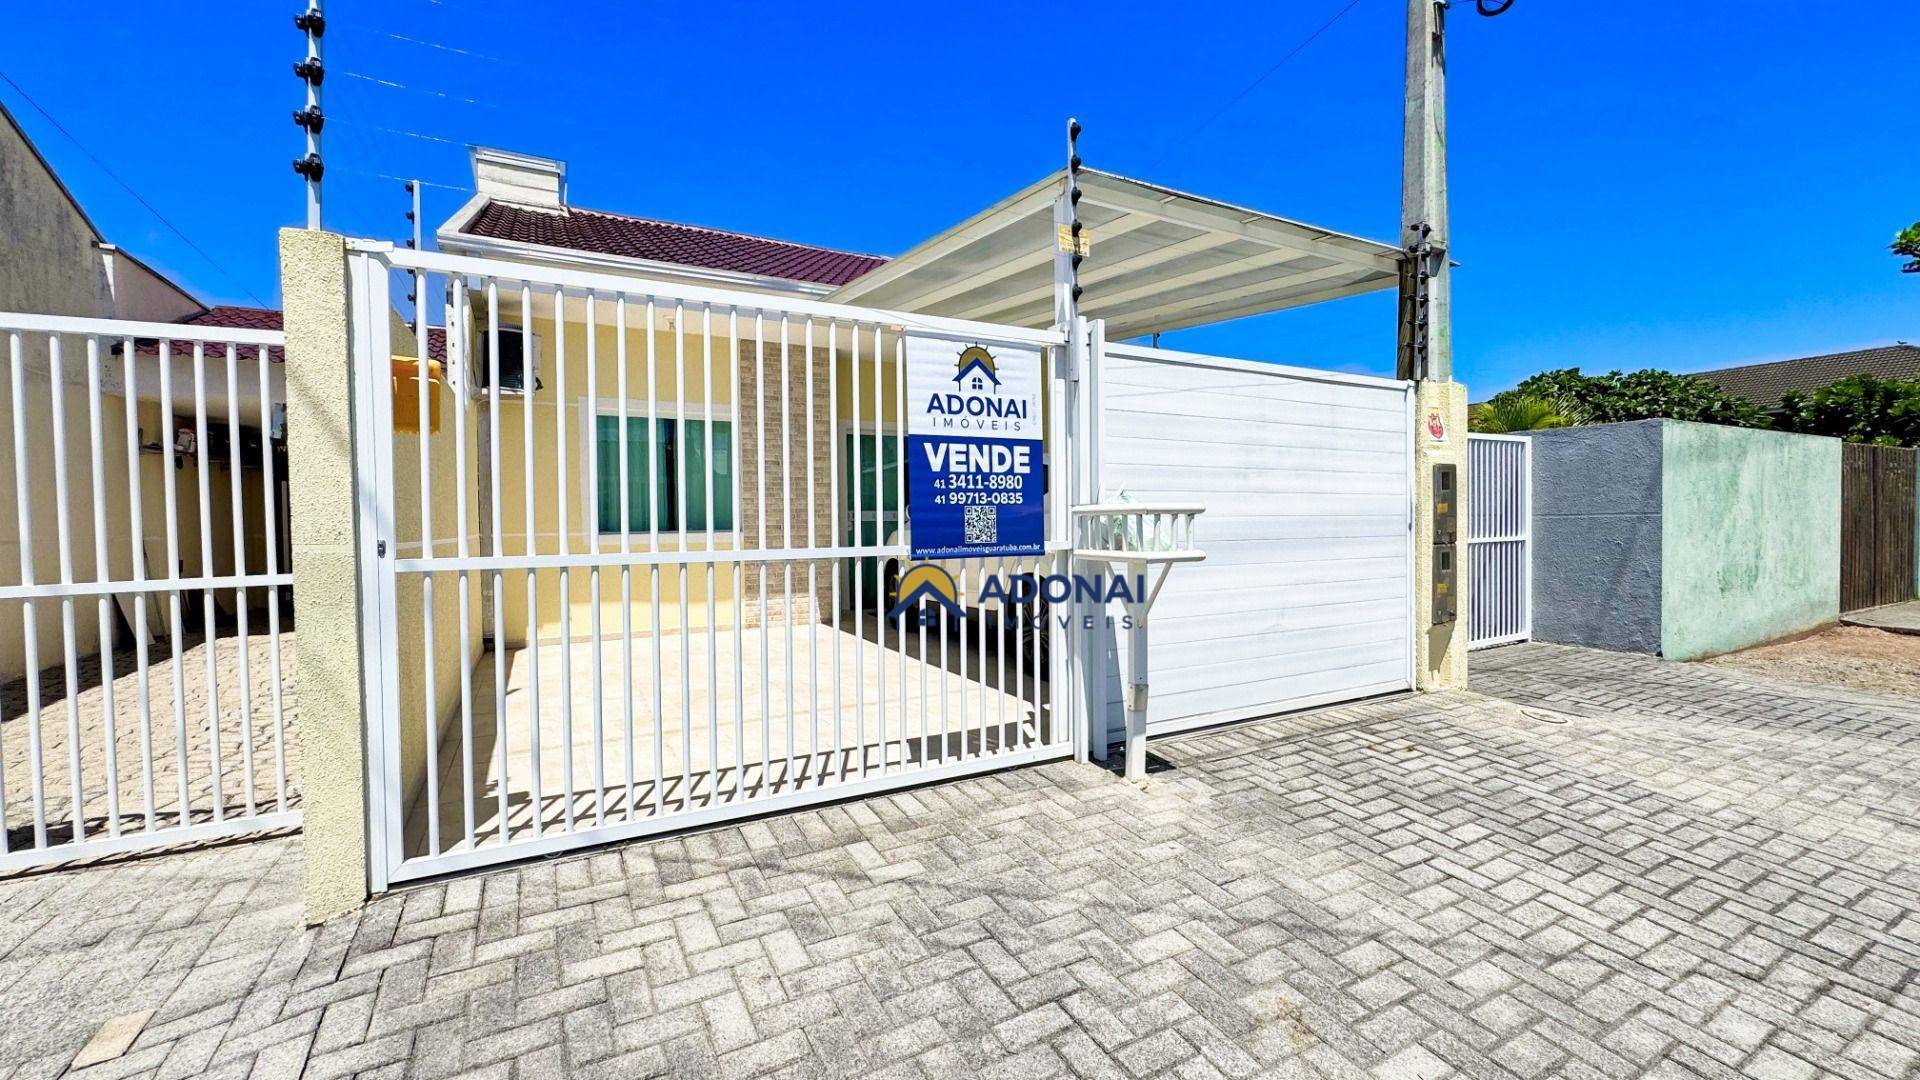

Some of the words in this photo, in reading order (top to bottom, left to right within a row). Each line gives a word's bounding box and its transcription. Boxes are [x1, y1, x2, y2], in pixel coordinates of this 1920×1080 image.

[926, 393, 1027, 419] ADONAI
[933, 415, 1022, 431] IMÓVEIS
[923, 442, 1031, 474] VENDE
[934, 479, 946, 489] 41
[948, 474, 1023, 489] 3411-8980
[934, 495, 946, 505] 41
[949, 492, 1023, 505] 99713-0835
